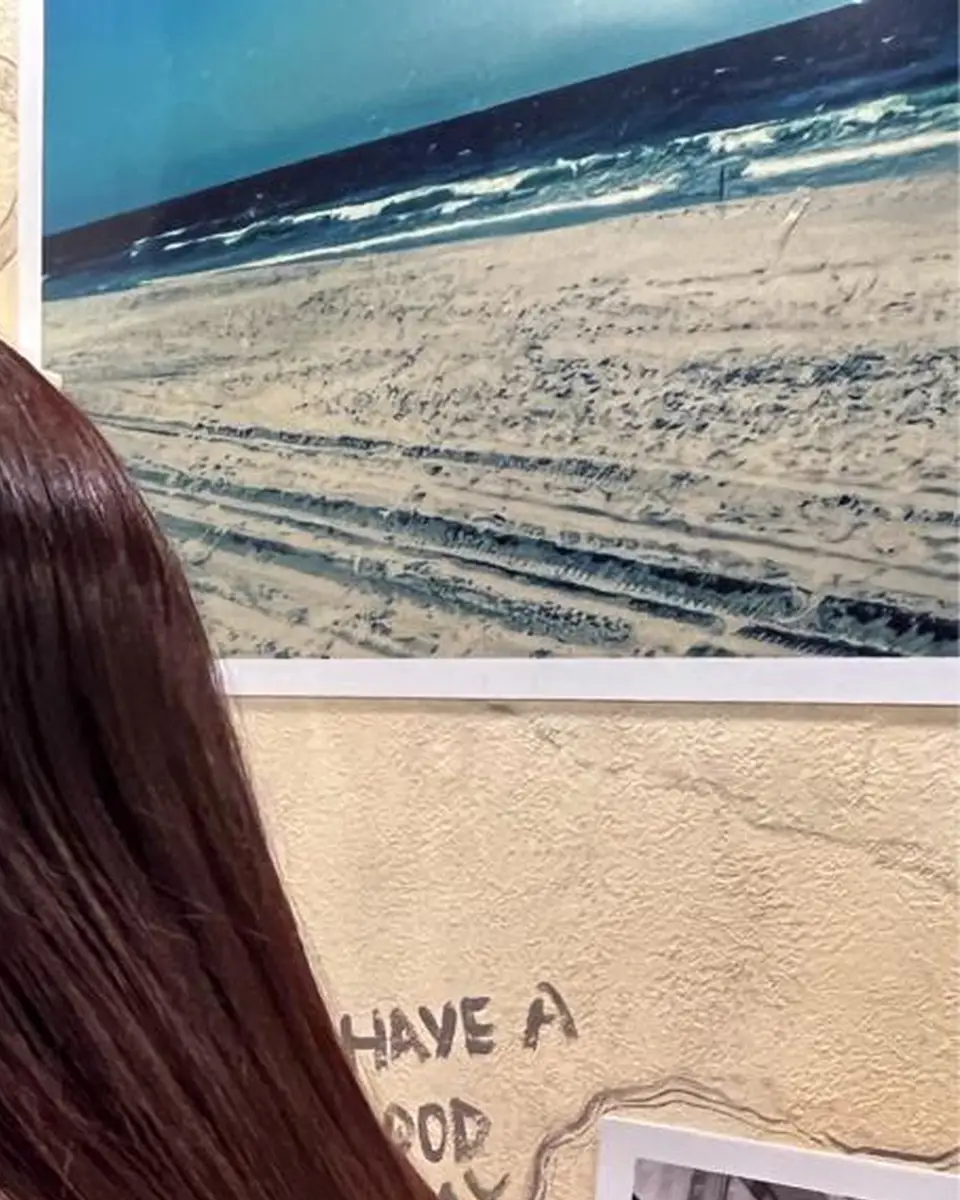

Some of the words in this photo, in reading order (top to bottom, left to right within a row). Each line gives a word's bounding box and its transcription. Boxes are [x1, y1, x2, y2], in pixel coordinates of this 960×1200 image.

[340, 996, 495, 1070] HAVE
[522, 981, 579, 1051] A
[382, 1097, 493, 1164] OOD
